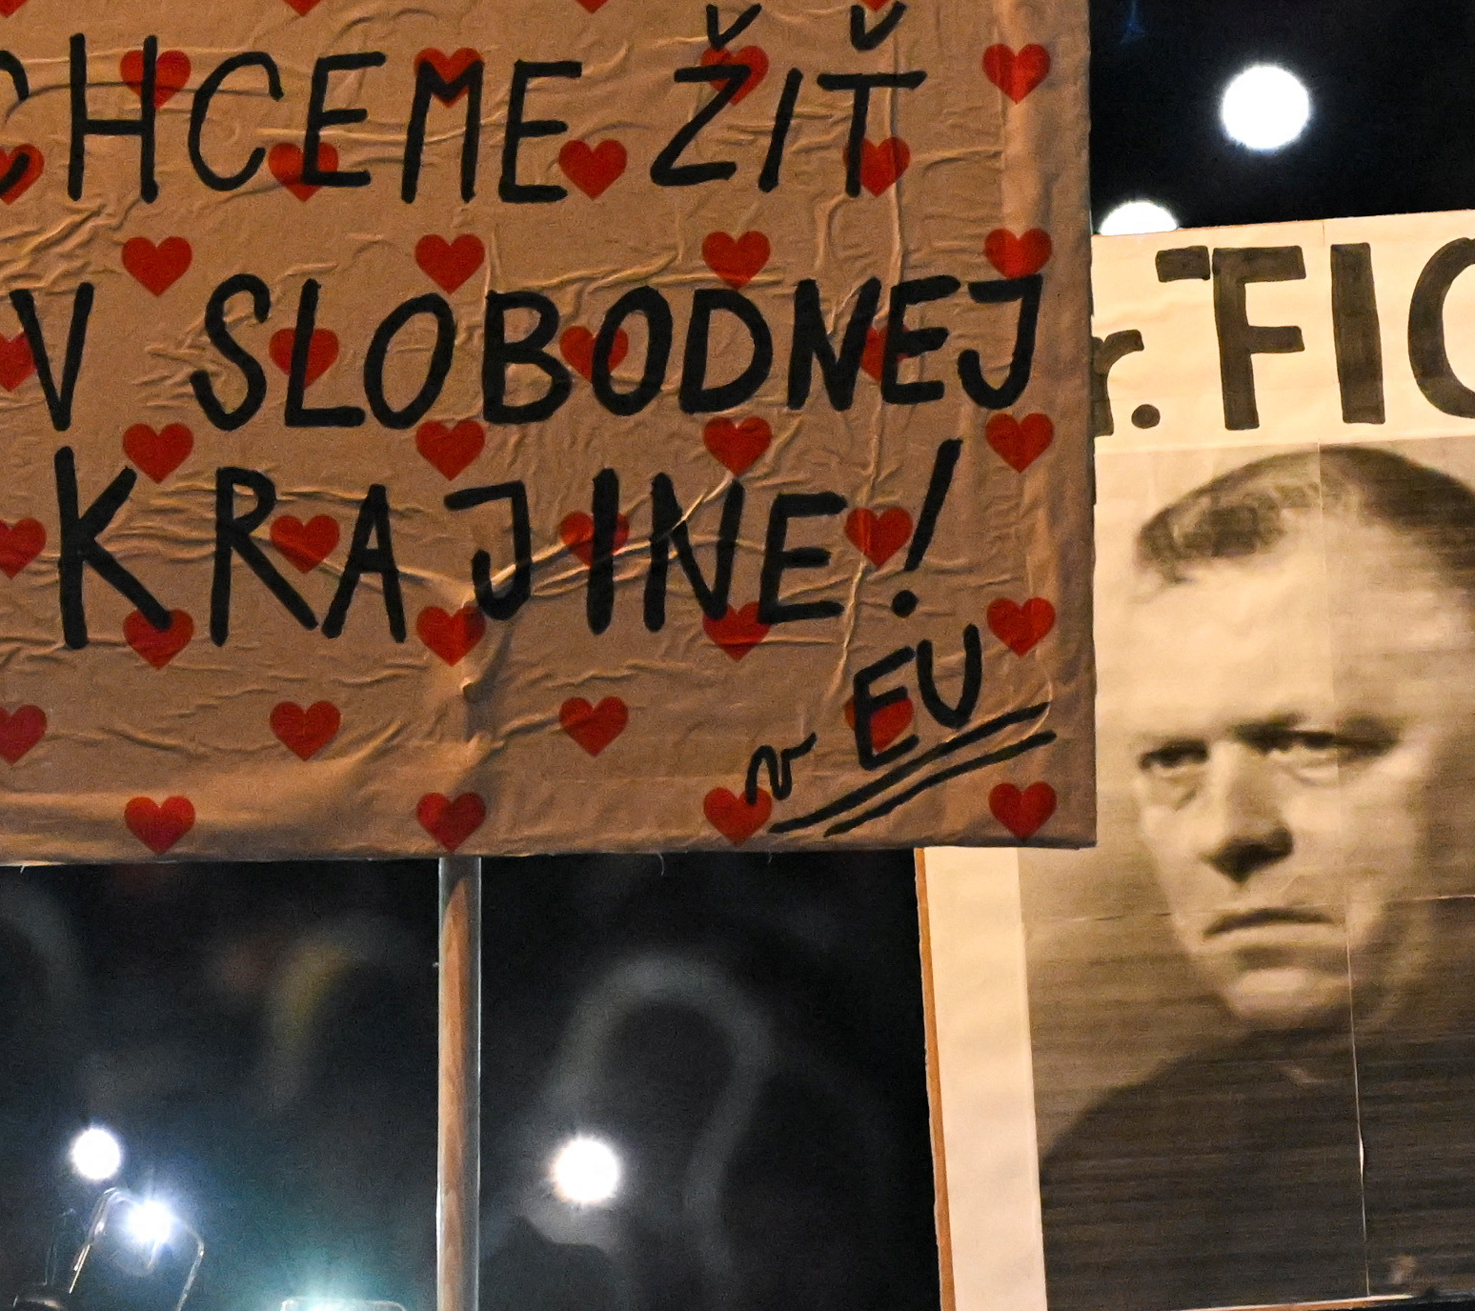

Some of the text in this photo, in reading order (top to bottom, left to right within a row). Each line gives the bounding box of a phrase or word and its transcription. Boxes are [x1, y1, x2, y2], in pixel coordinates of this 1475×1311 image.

[650, 1, 926, 196] ŽIŤ
[9, 272, 1043, 431] V SLOBODNEJ
[53, 439, 964, 649] KRAJINE!
[851, 626, 982, 768] EU
